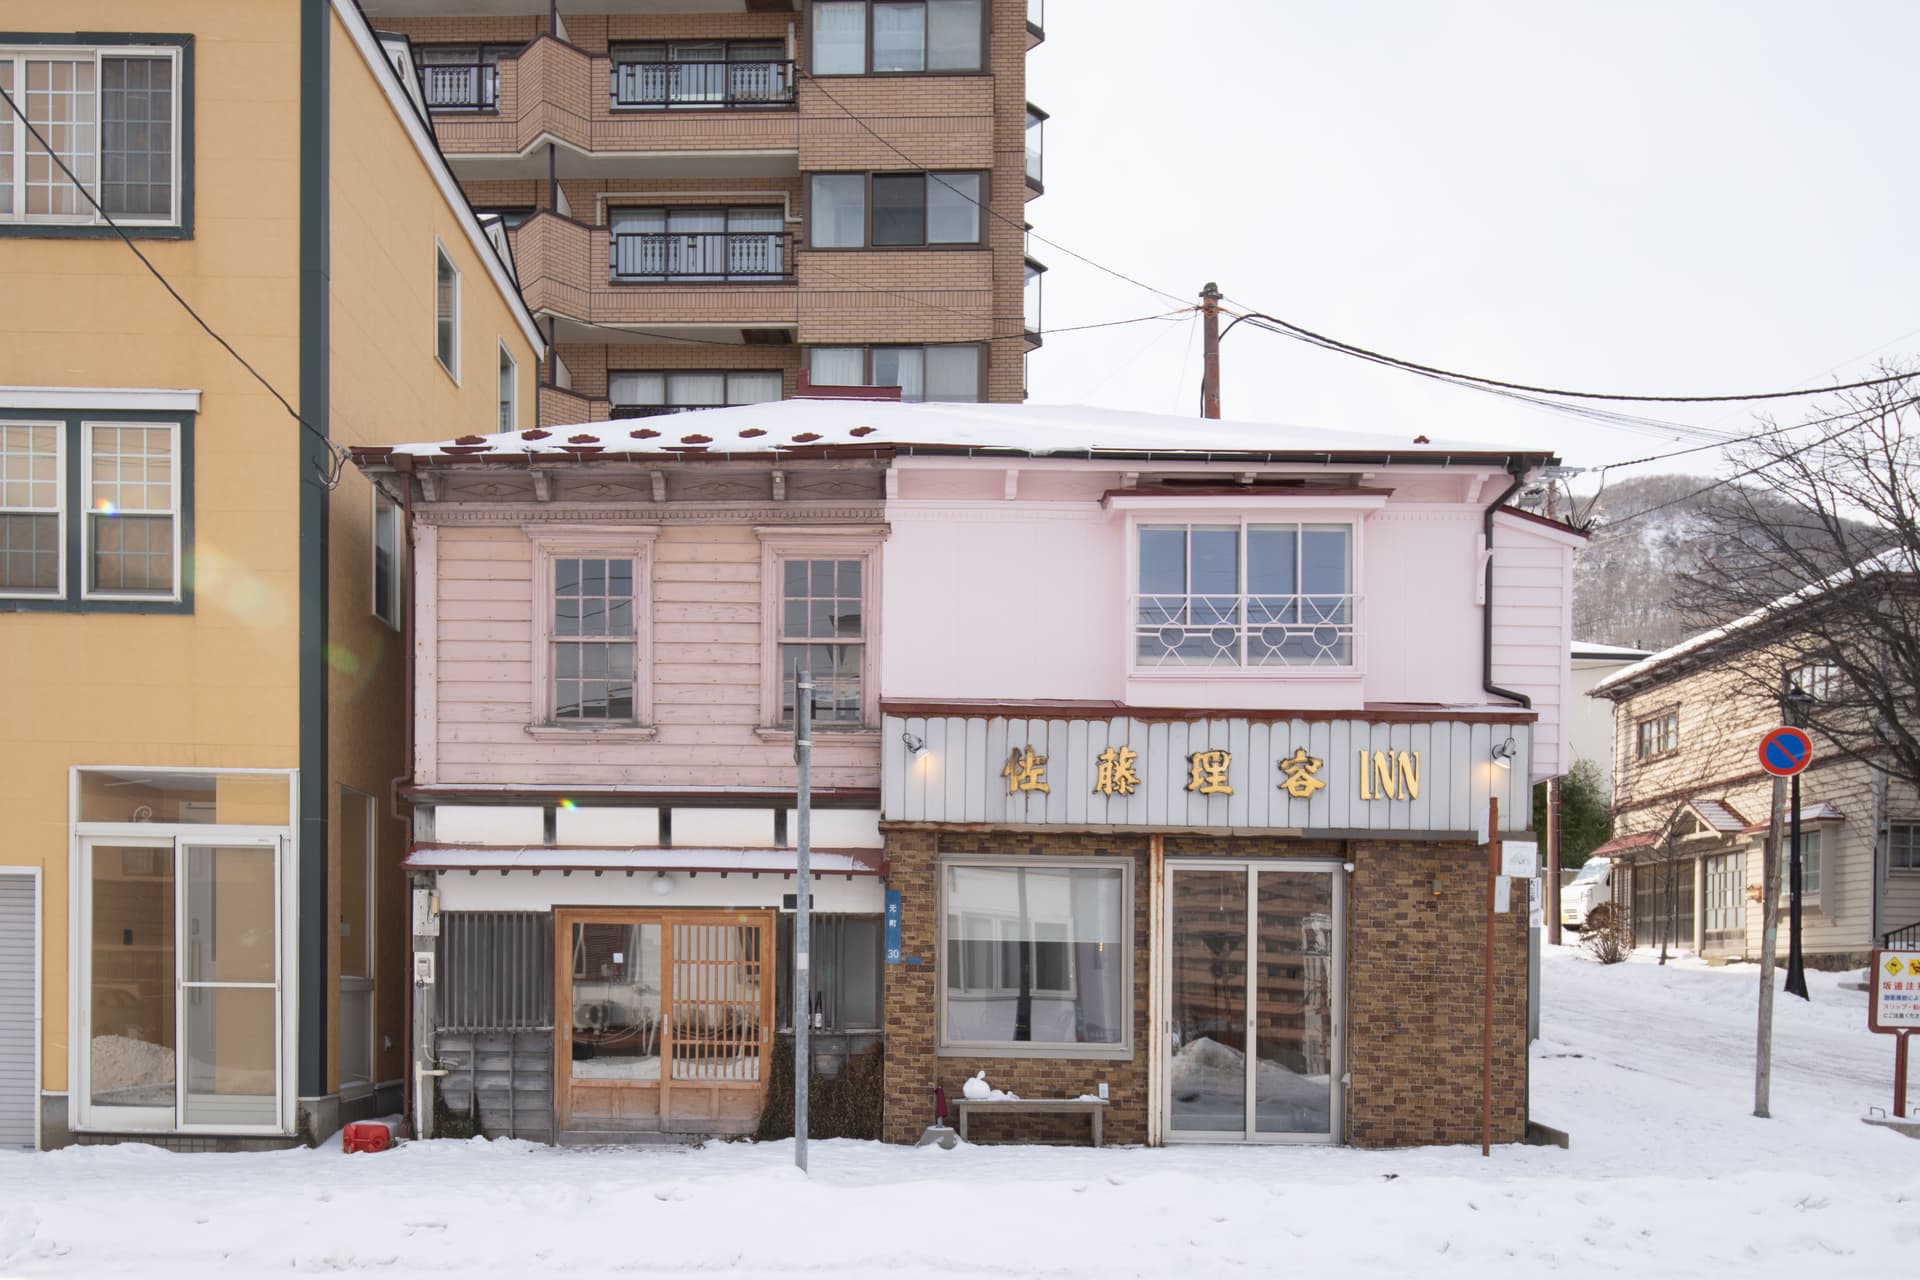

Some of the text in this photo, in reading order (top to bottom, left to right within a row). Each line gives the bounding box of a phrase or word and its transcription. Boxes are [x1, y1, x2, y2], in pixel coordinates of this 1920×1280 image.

[1002, 744, 1420, 801] 佐藤理容 INN
[887, 949, 899, 959] 30
